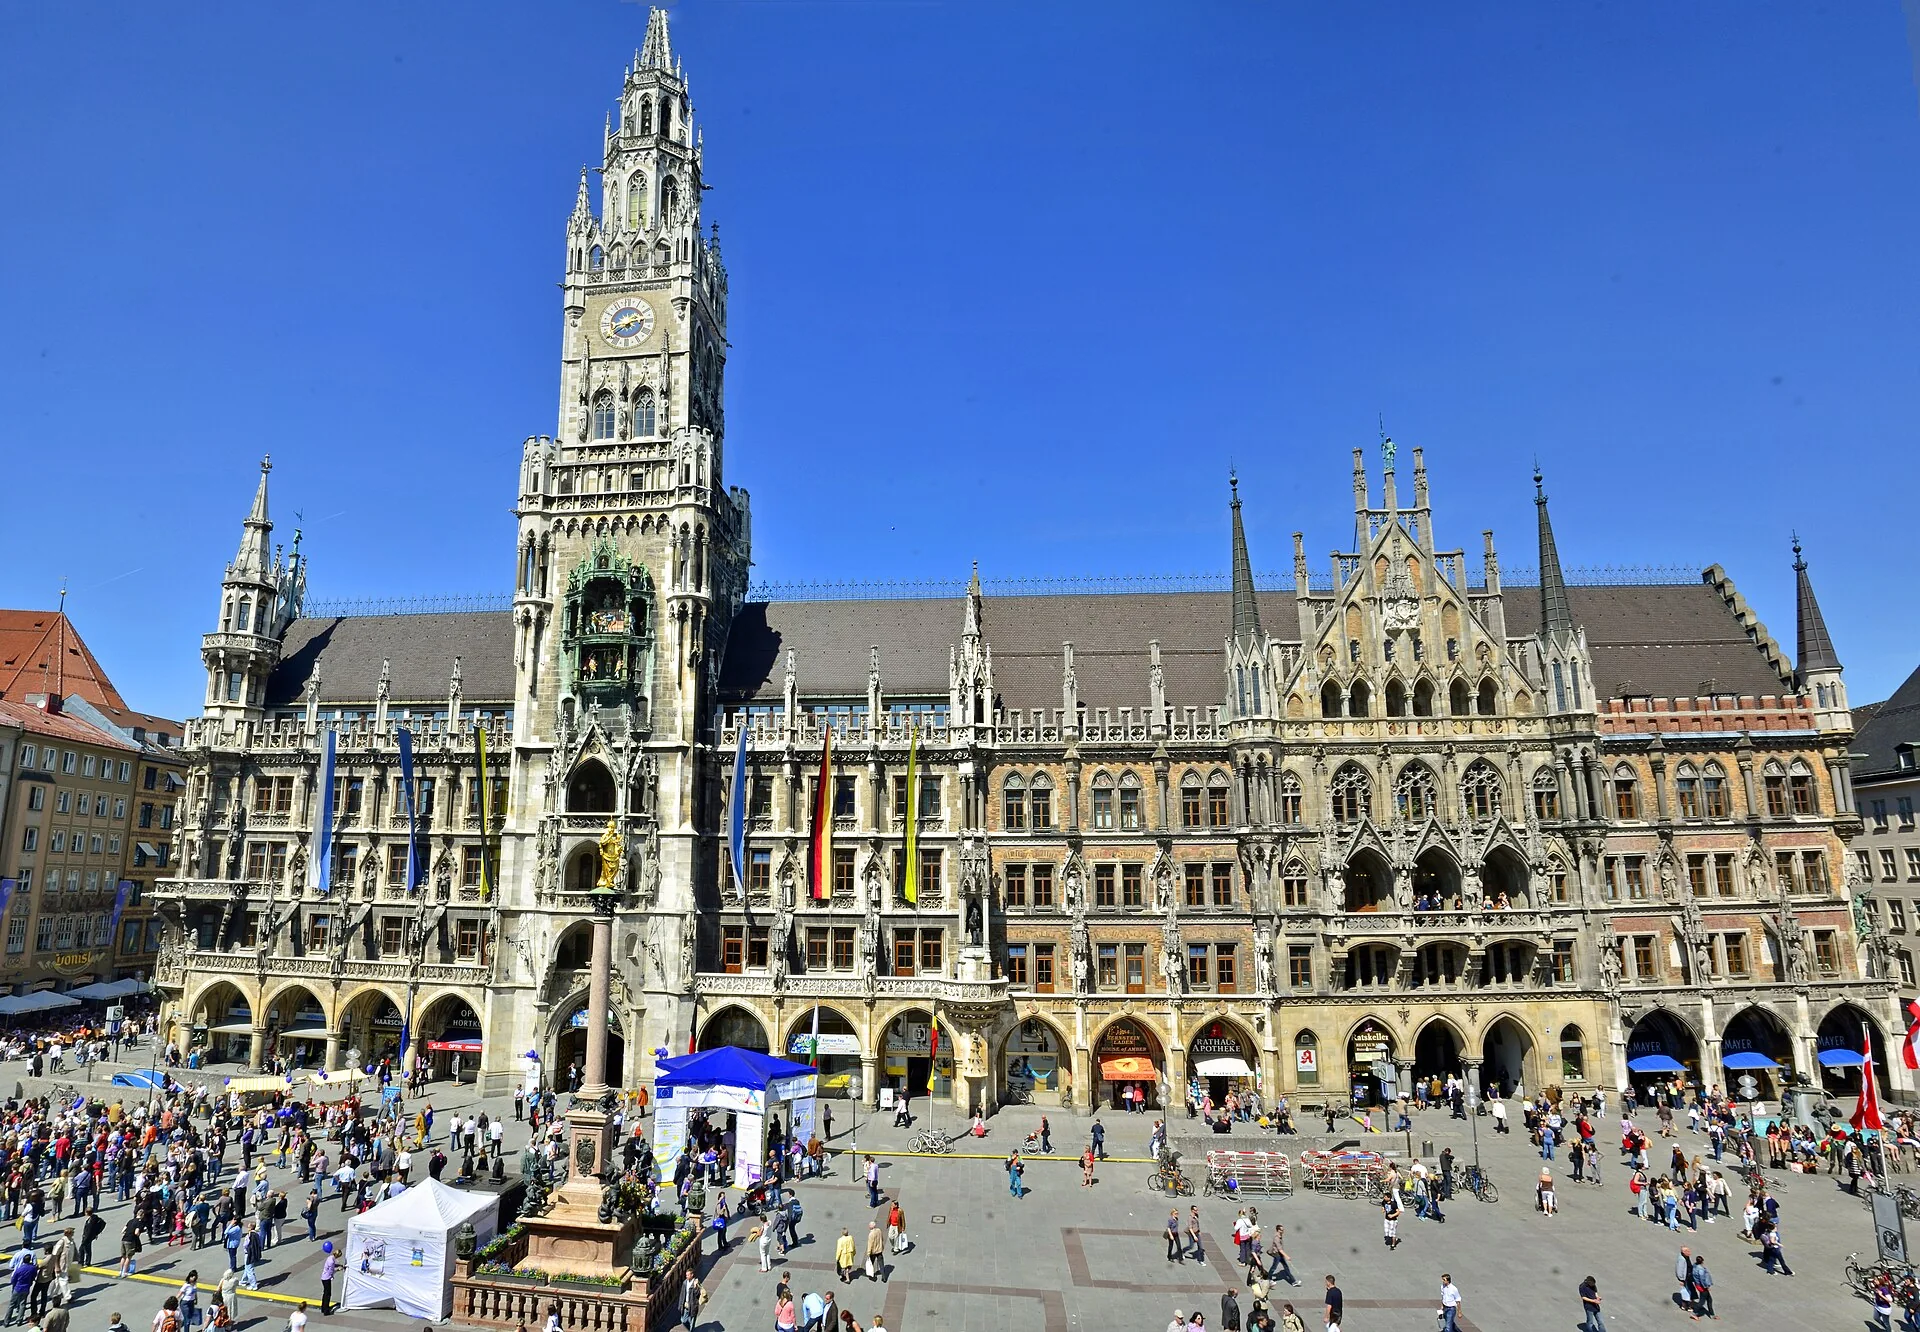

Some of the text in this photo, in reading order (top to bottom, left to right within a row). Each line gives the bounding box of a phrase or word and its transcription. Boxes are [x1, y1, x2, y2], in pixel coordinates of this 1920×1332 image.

[113, 1007, 122, 1019] S
[111, 1021, 120, 1034] U
[1196, 1038, 1236, 1046] RATHAUS
[1633, 1041, 1662, 1052] MAYER
[1724, 1039, 1753, 1049] MAYER
[1192, 1044, 1241, 1052] APOTHEKE
